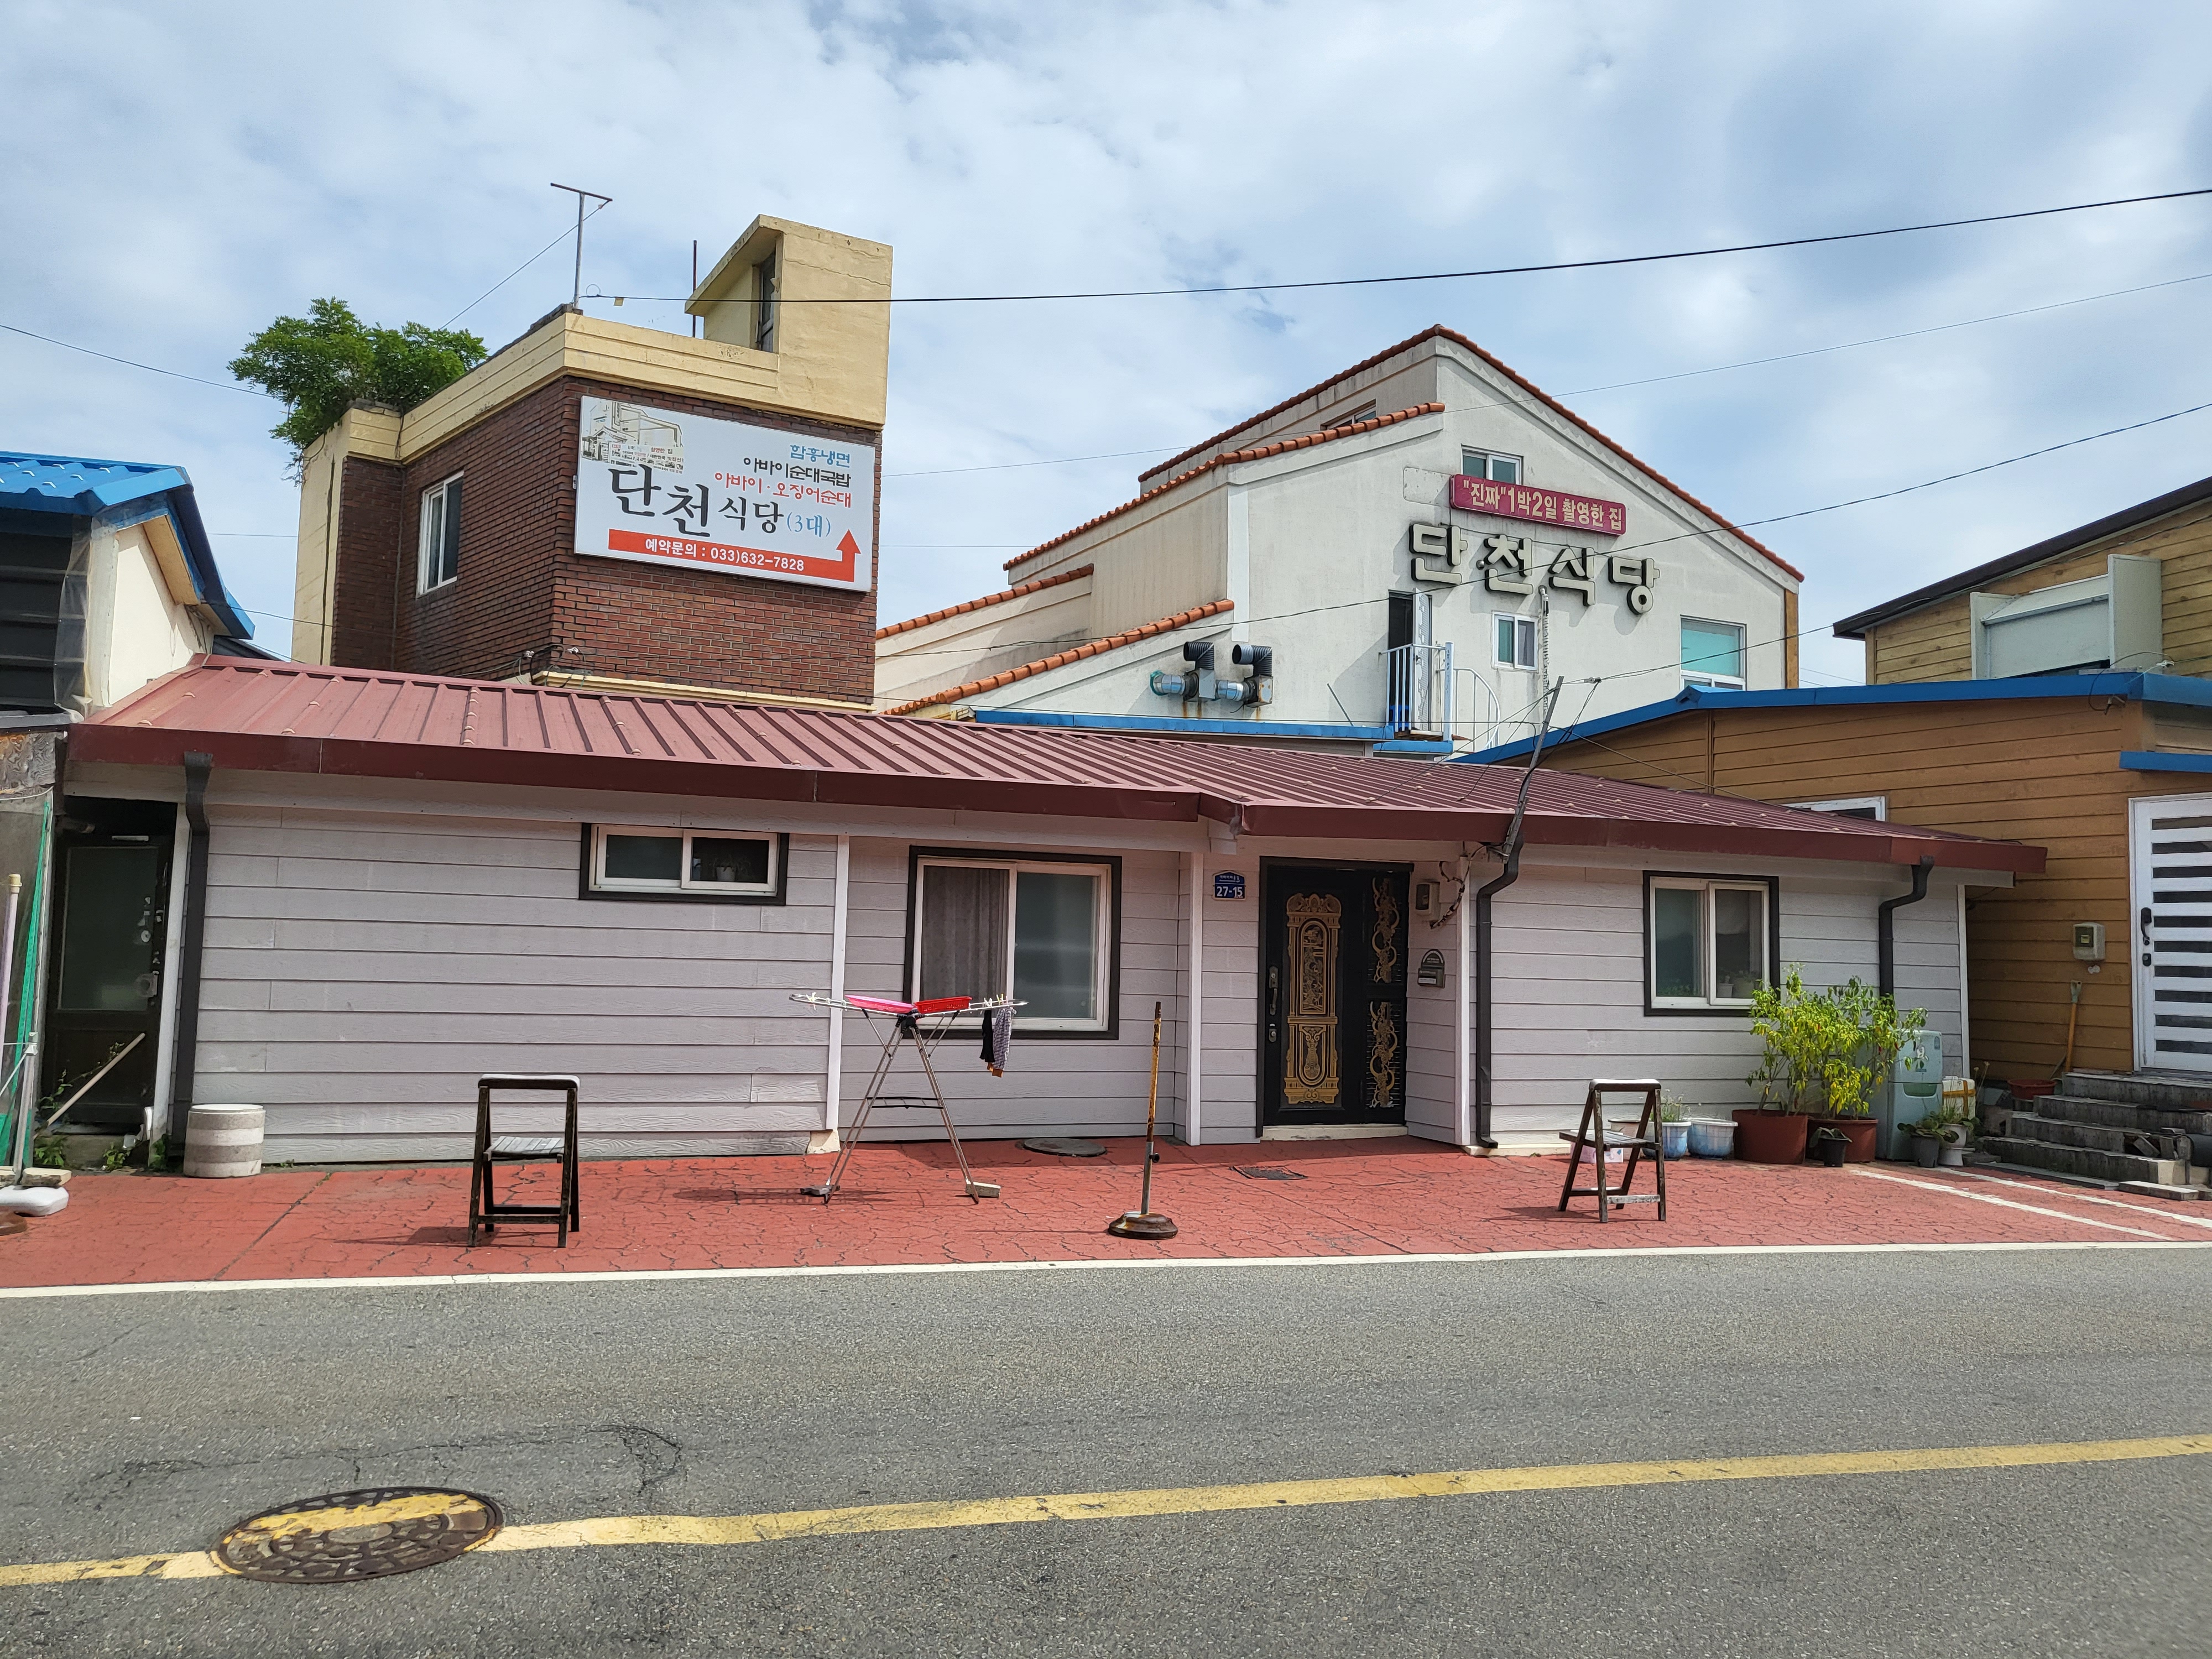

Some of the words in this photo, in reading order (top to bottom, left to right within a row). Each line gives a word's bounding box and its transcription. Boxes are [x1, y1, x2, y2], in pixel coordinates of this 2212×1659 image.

[790, 444, 850, 468] 함흥냉면
[743, 457, 851, 488] 아바이순대국밥
[1562, 498, 1604, 528] 촬영한
[1609, 507, 1622, 531] 집
[645, 538, 697, 557] 예약문의
[711, 547, 805, 572] 033)632-7828
[1217, 886, 1243, 897] 27-15
